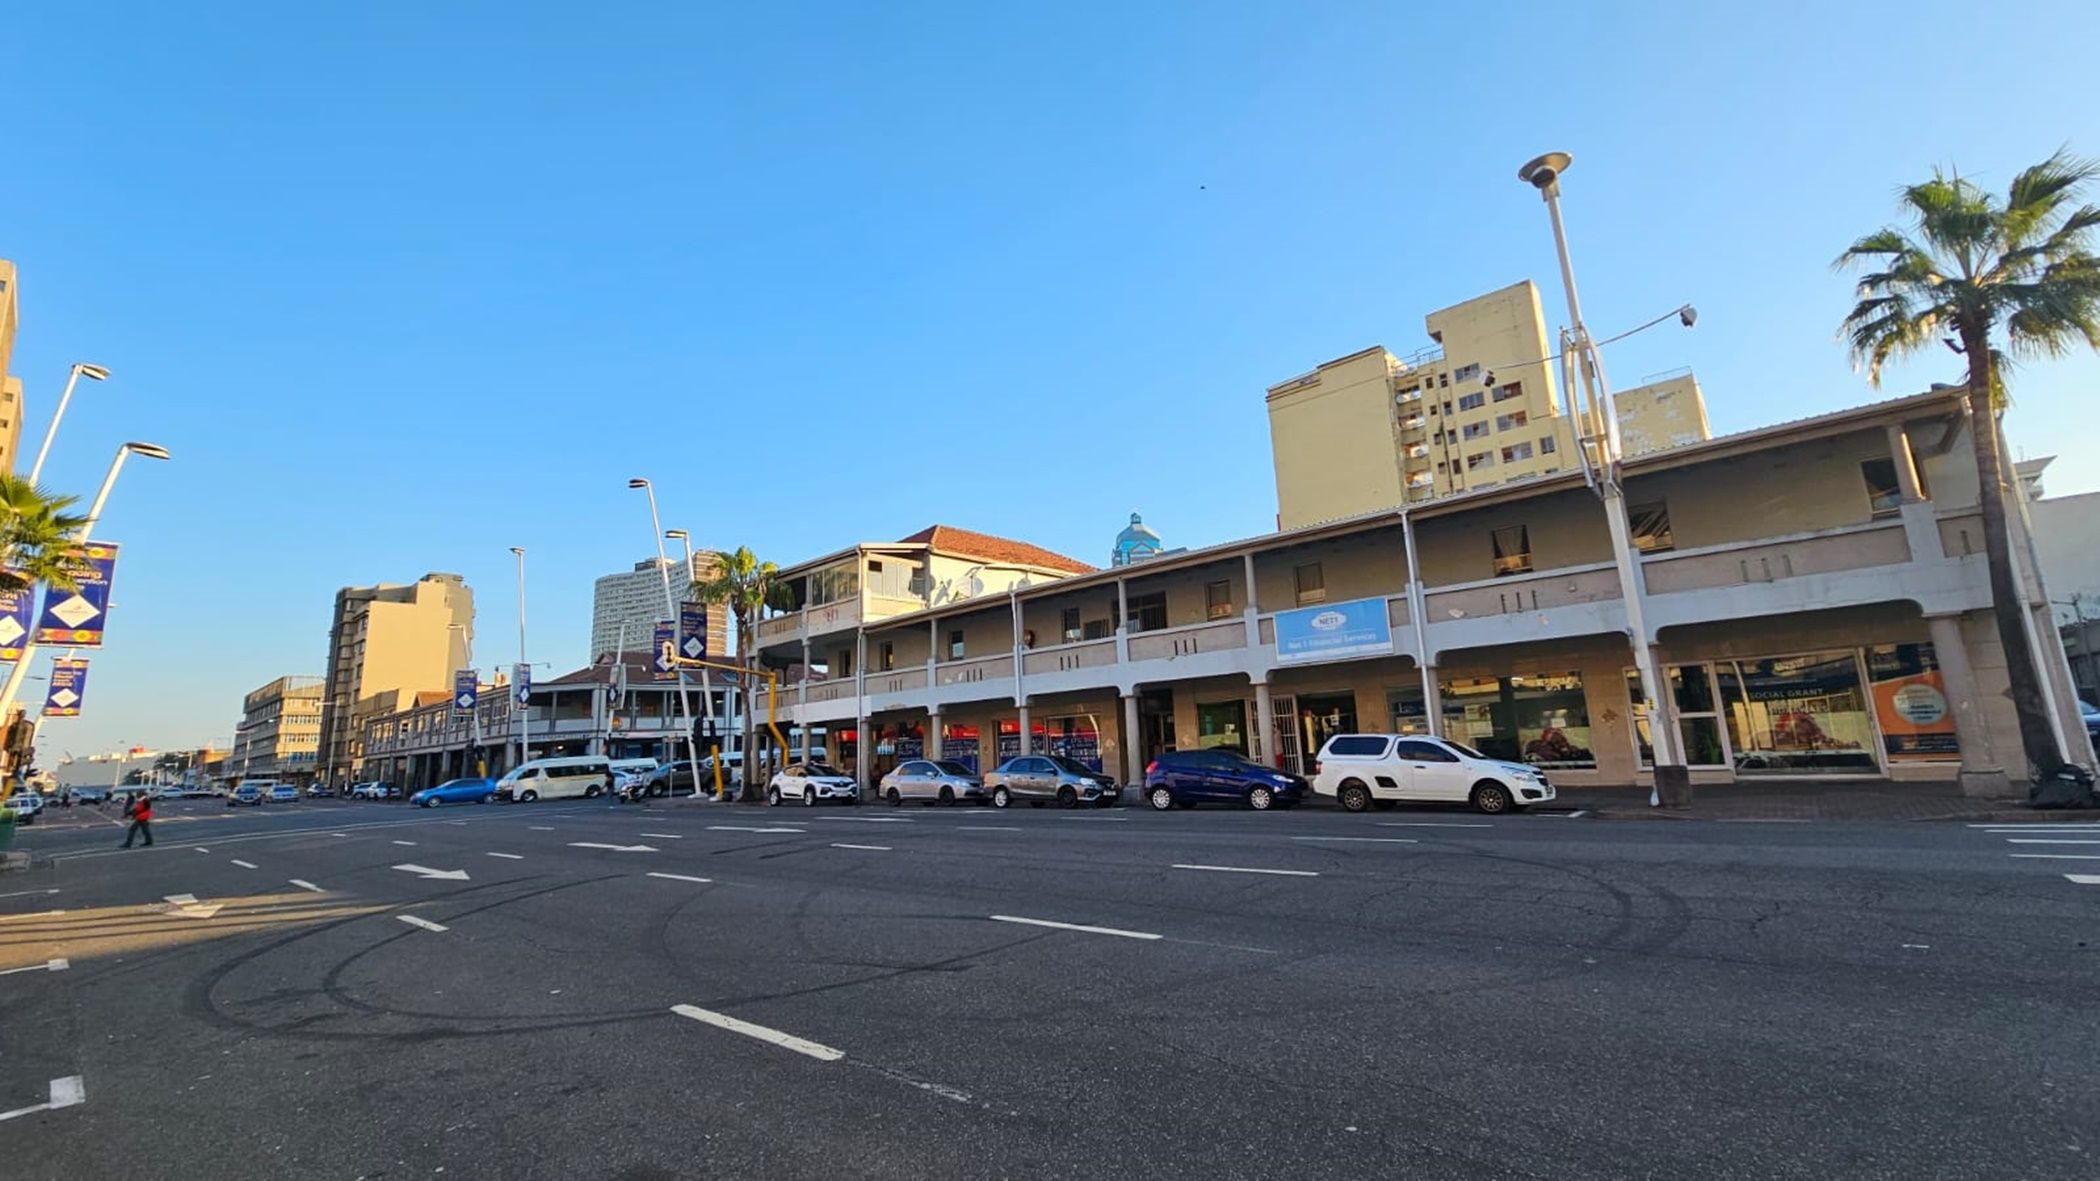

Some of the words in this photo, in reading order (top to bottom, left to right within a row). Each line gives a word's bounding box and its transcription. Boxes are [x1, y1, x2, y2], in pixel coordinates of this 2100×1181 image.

[1343, 632, 1376, 642] Services
[1750, 690, 1785, 699] SOCIAL
[1787, 688, 1824, 697] GRANT
